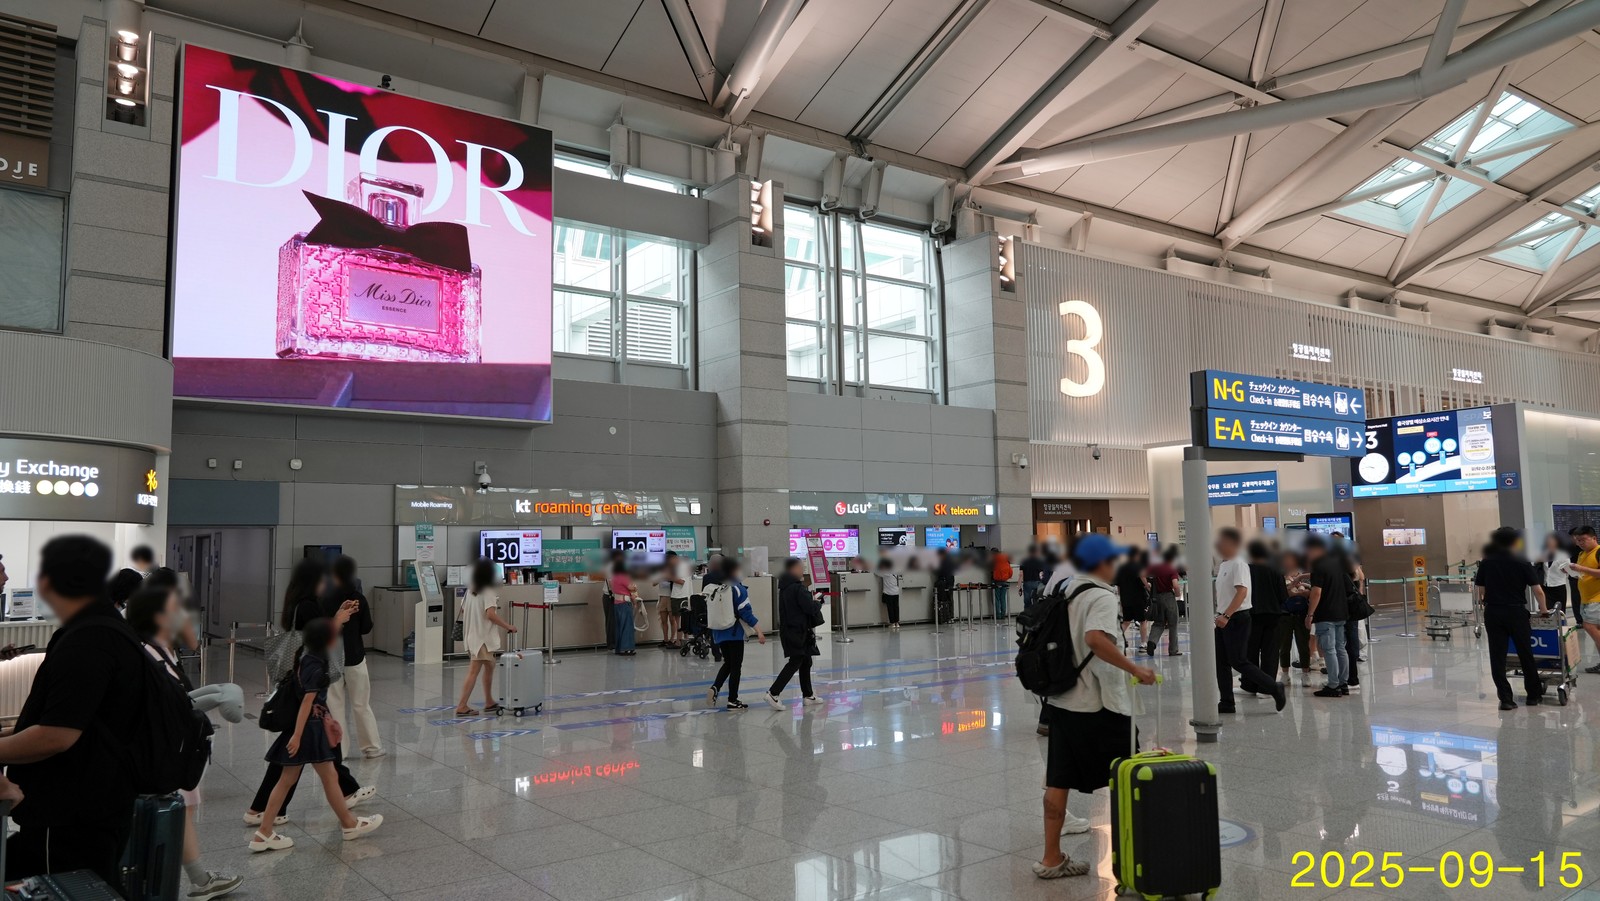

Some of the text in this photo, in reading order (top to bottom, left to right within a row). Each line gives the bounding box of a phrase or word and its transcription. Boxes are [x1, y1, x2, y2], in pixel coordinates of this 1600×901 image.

[202, 84, 536, 237] DIOR
[354, 283, 432, 308] Miss Dior
[381, 305, 407, 314] ESSENCE
[1058, 299, 1106, 398] 3
[1213, 378, 1245, 403] N-G
[1249, 395, 1273, 406] Check-in
[1214, 417, 1246, 442] E-A
[1250, 433, 1274, 444] Check-in
[1364, 431, 1379, 449] 3
[16, 458, 99, 482] Exchange
[430, 501, 453, 510] Roaming
[515, 499, 639, 517] kt roaming center
[934, 503, 979, 516] SK telecom
[486, 542, 519, 561] 130
